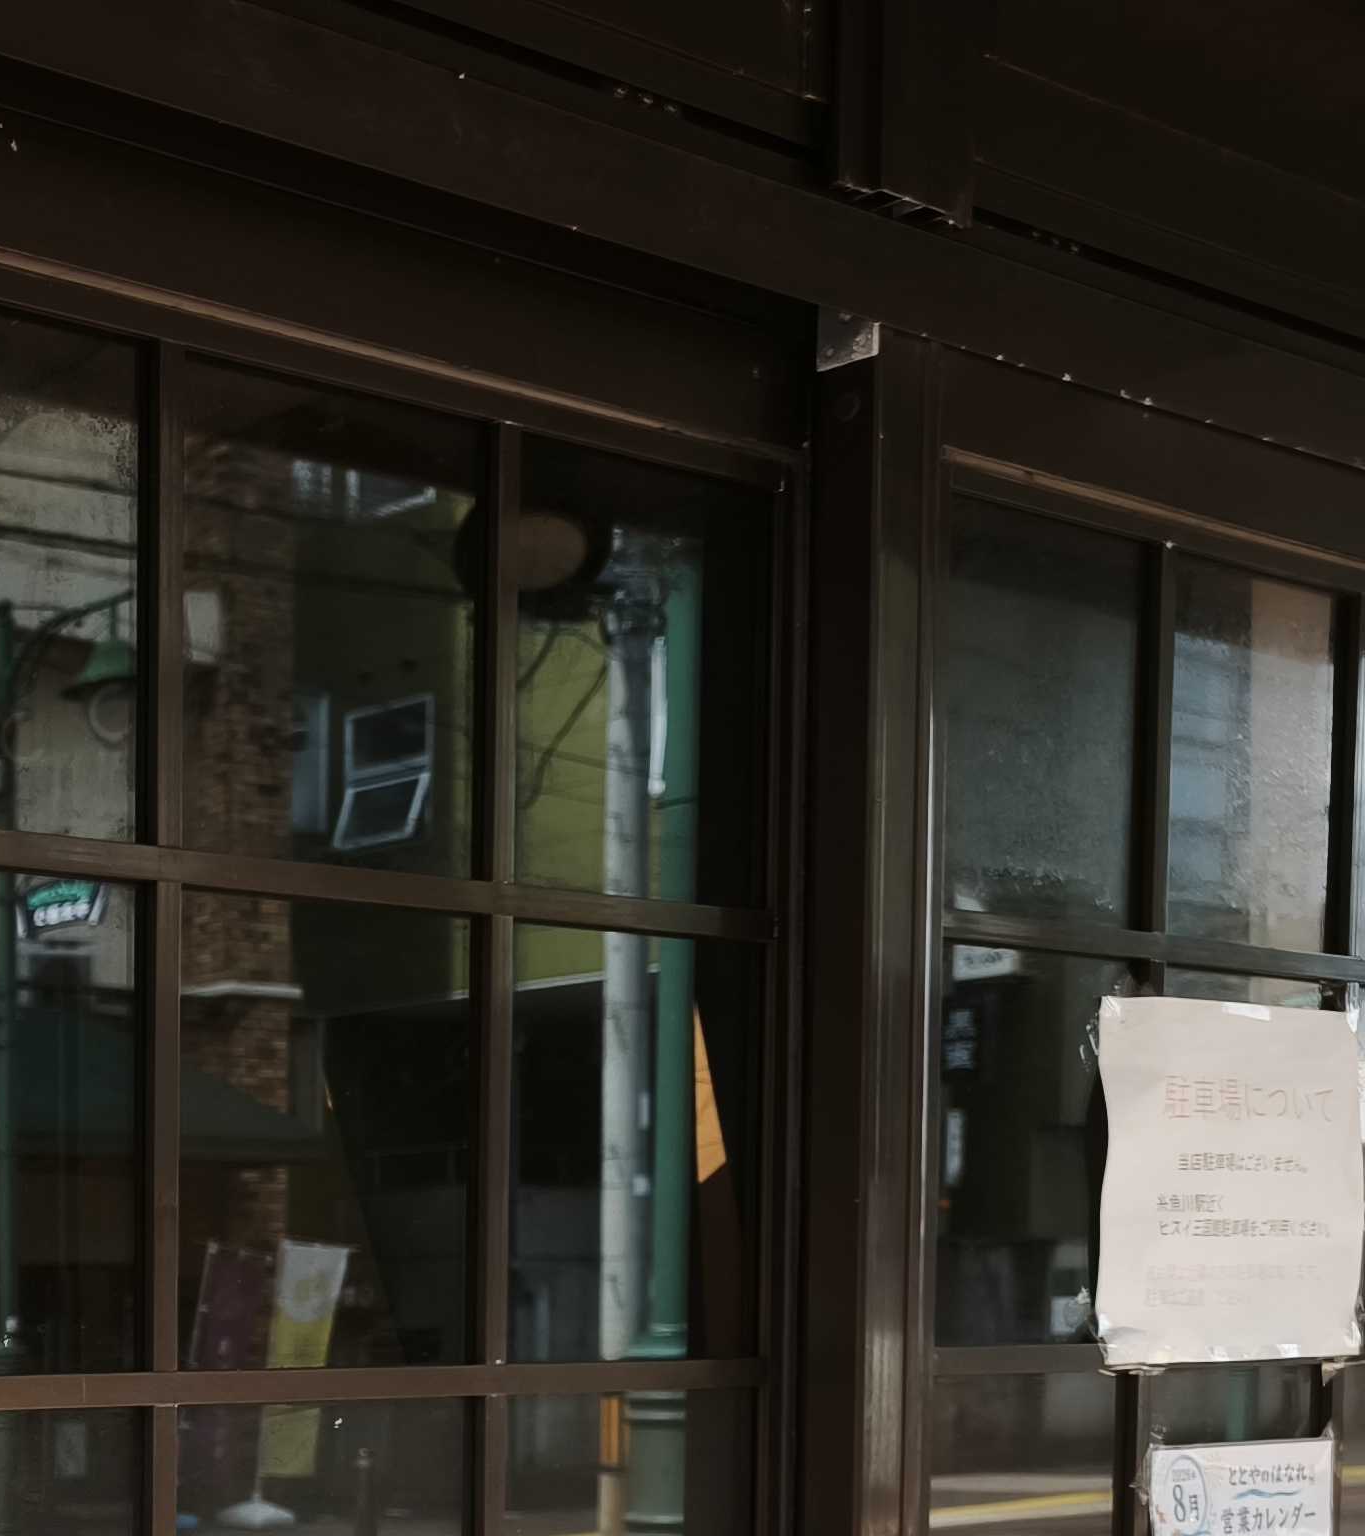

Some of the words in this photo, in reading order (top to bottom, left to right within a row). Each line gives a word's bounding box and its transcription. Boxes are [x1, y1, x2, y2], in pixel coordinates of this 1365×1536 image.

[1163, 1074, 1334, 1123] 駐車場について
[1220, 1502, 1317, 1535] 営業カレンダー
